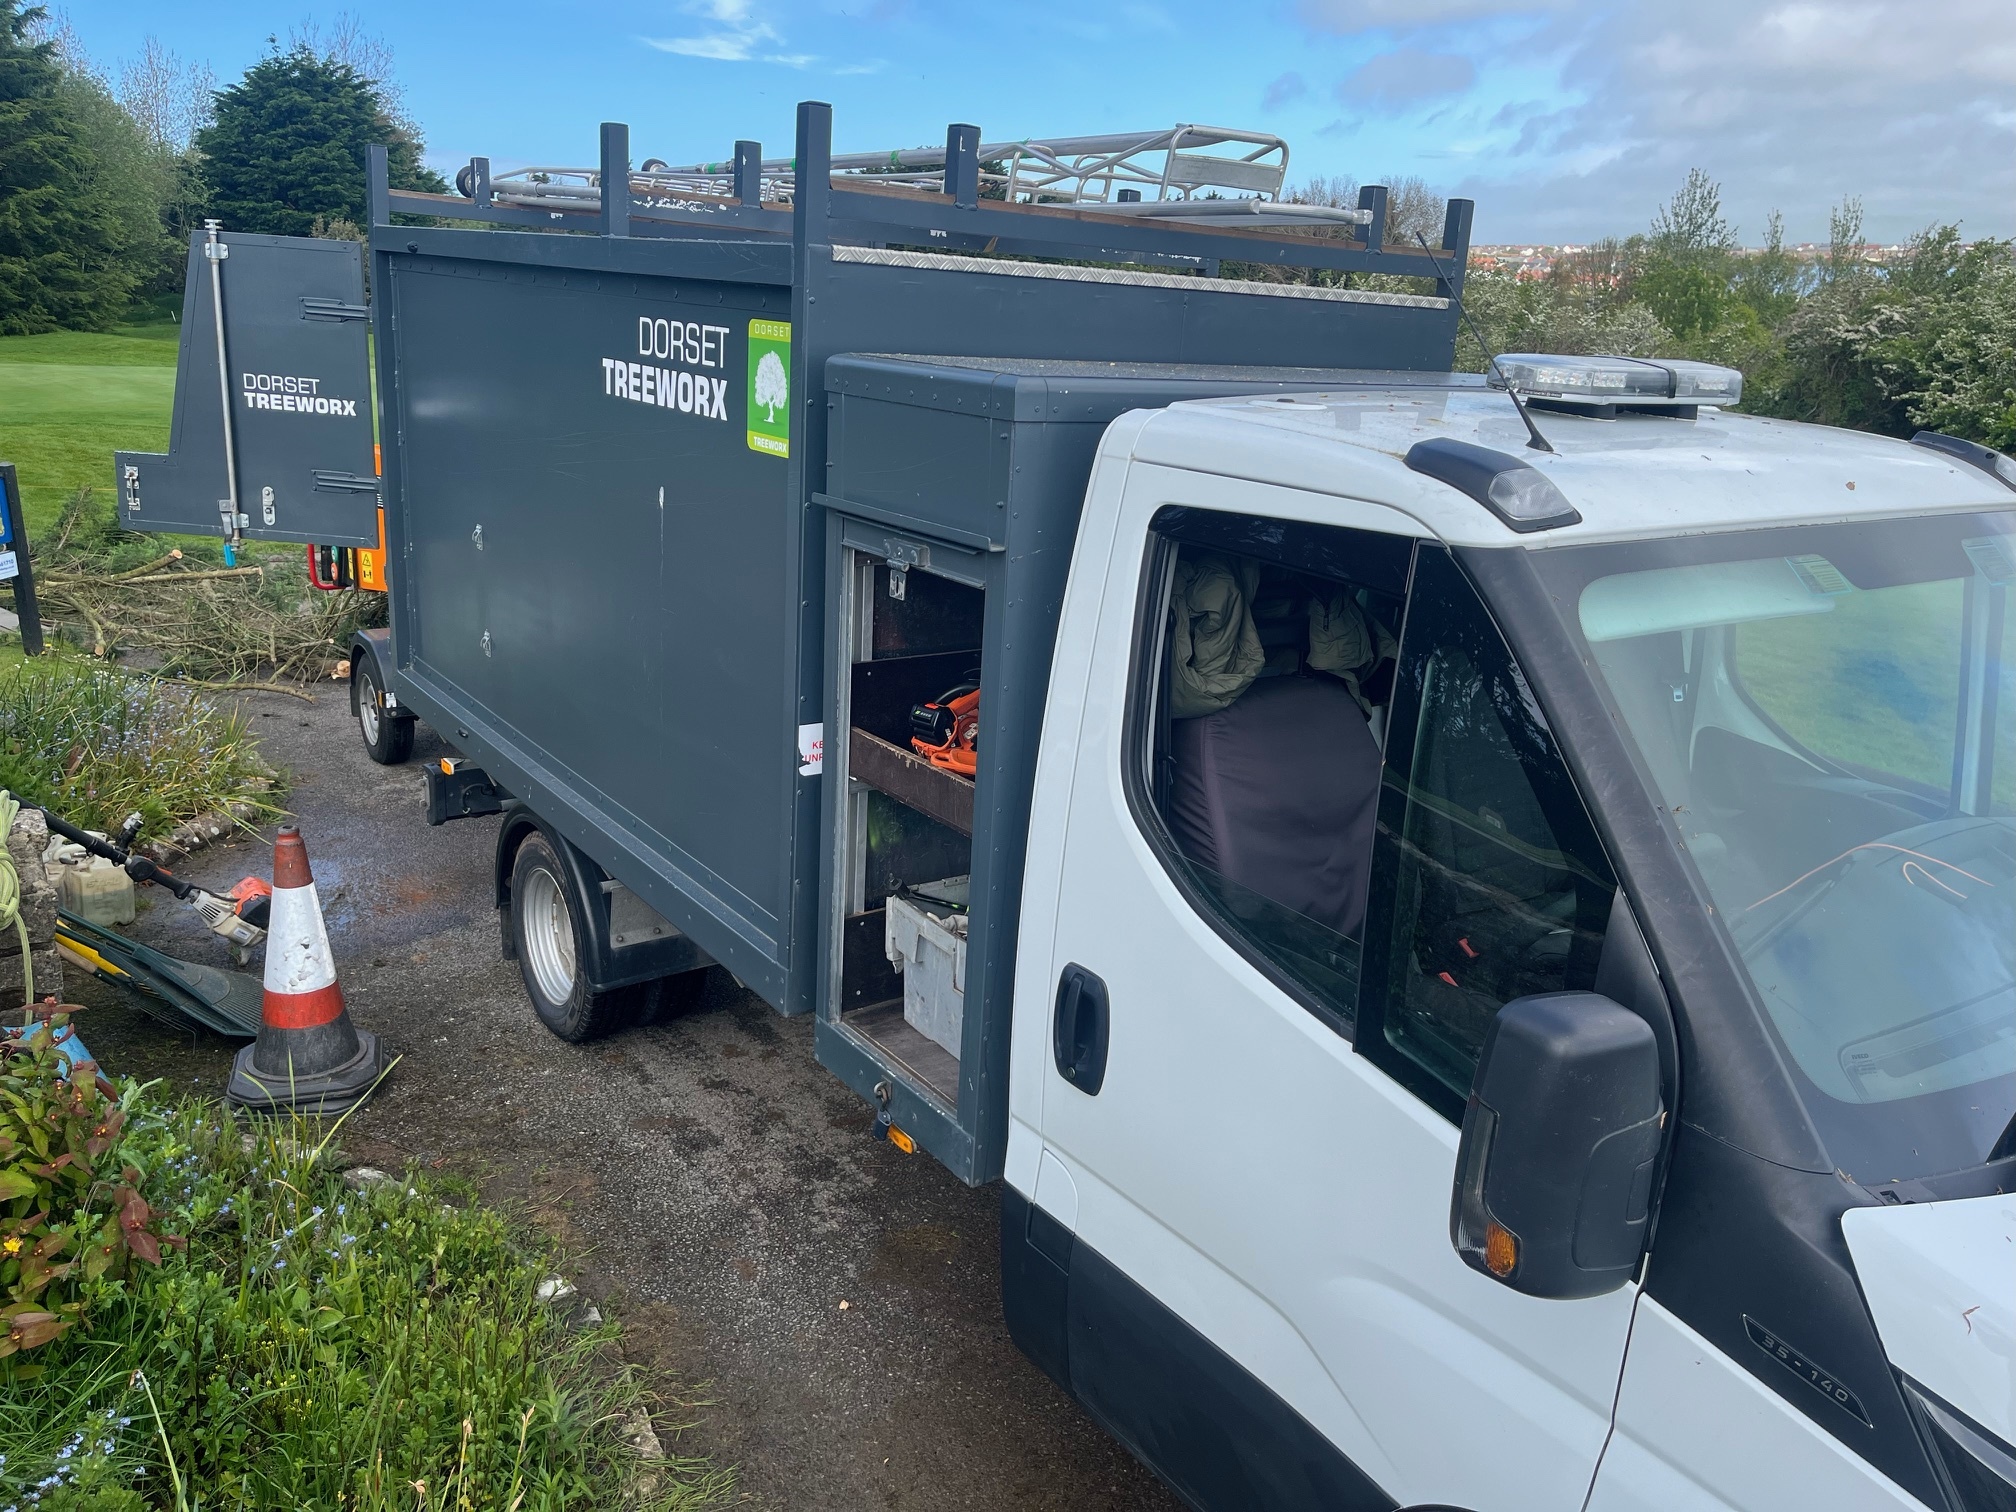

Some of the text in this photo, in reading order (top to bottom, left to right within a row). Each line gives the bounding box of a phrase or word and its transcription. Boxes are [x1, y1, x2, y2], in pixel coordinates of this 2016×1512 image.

[754, 323, 790, 337] DORSET
[639, 316, 730, 369] DORSET
[242, 372, 321, 395] DORSET
[602, 357, 728, 422] TREEWORX
[243, 391, 357, 417] TREEWORX
[753, 435, 788, 453] TREEWORX
